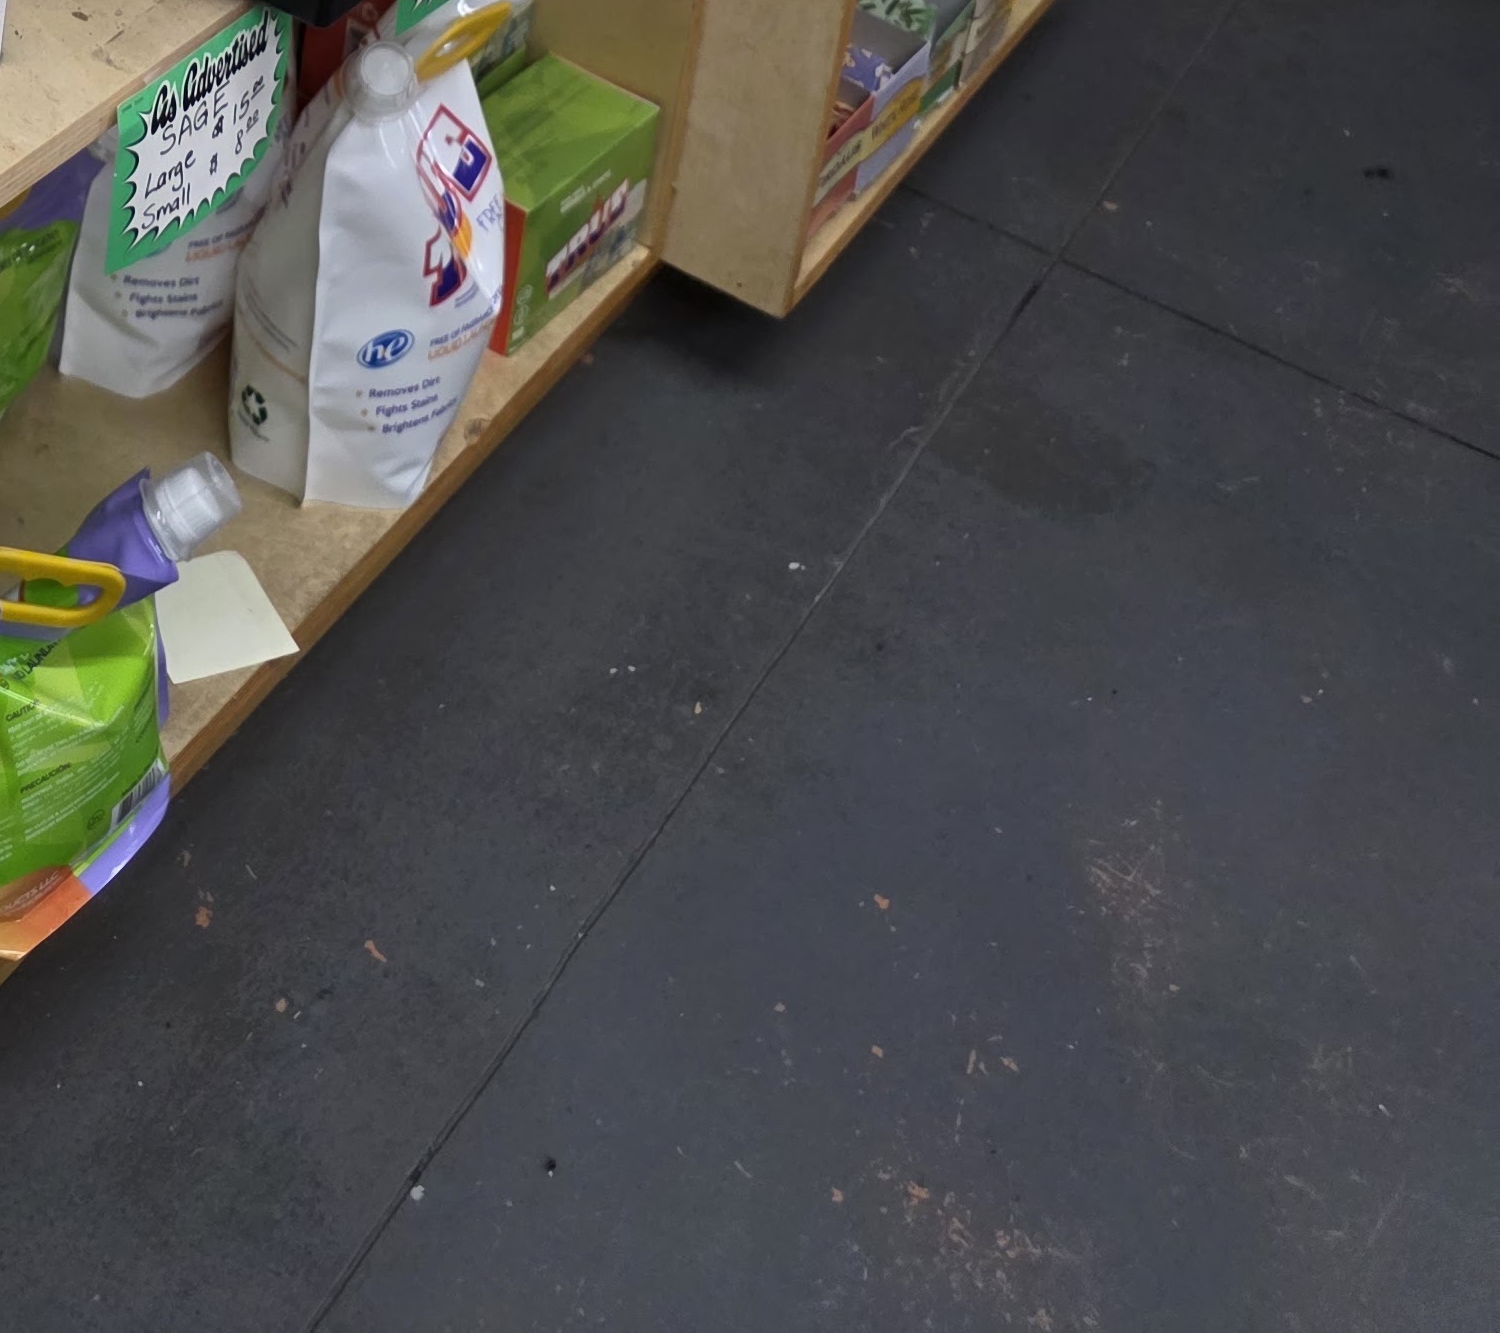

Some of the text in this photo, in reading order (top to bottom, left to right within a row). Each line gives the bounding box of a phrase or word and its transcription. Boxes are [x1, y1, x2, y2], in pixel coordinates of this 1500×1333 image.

[182, 9, 269, 113] Advertised
[160, 80, 231, 156] SAGE
[144, 149, 197, 200] Large
[140, 182, 191, 231] Small
[368, 375, 441, 399] Removes Dirt
[375, 399, 408, 418] Fights
